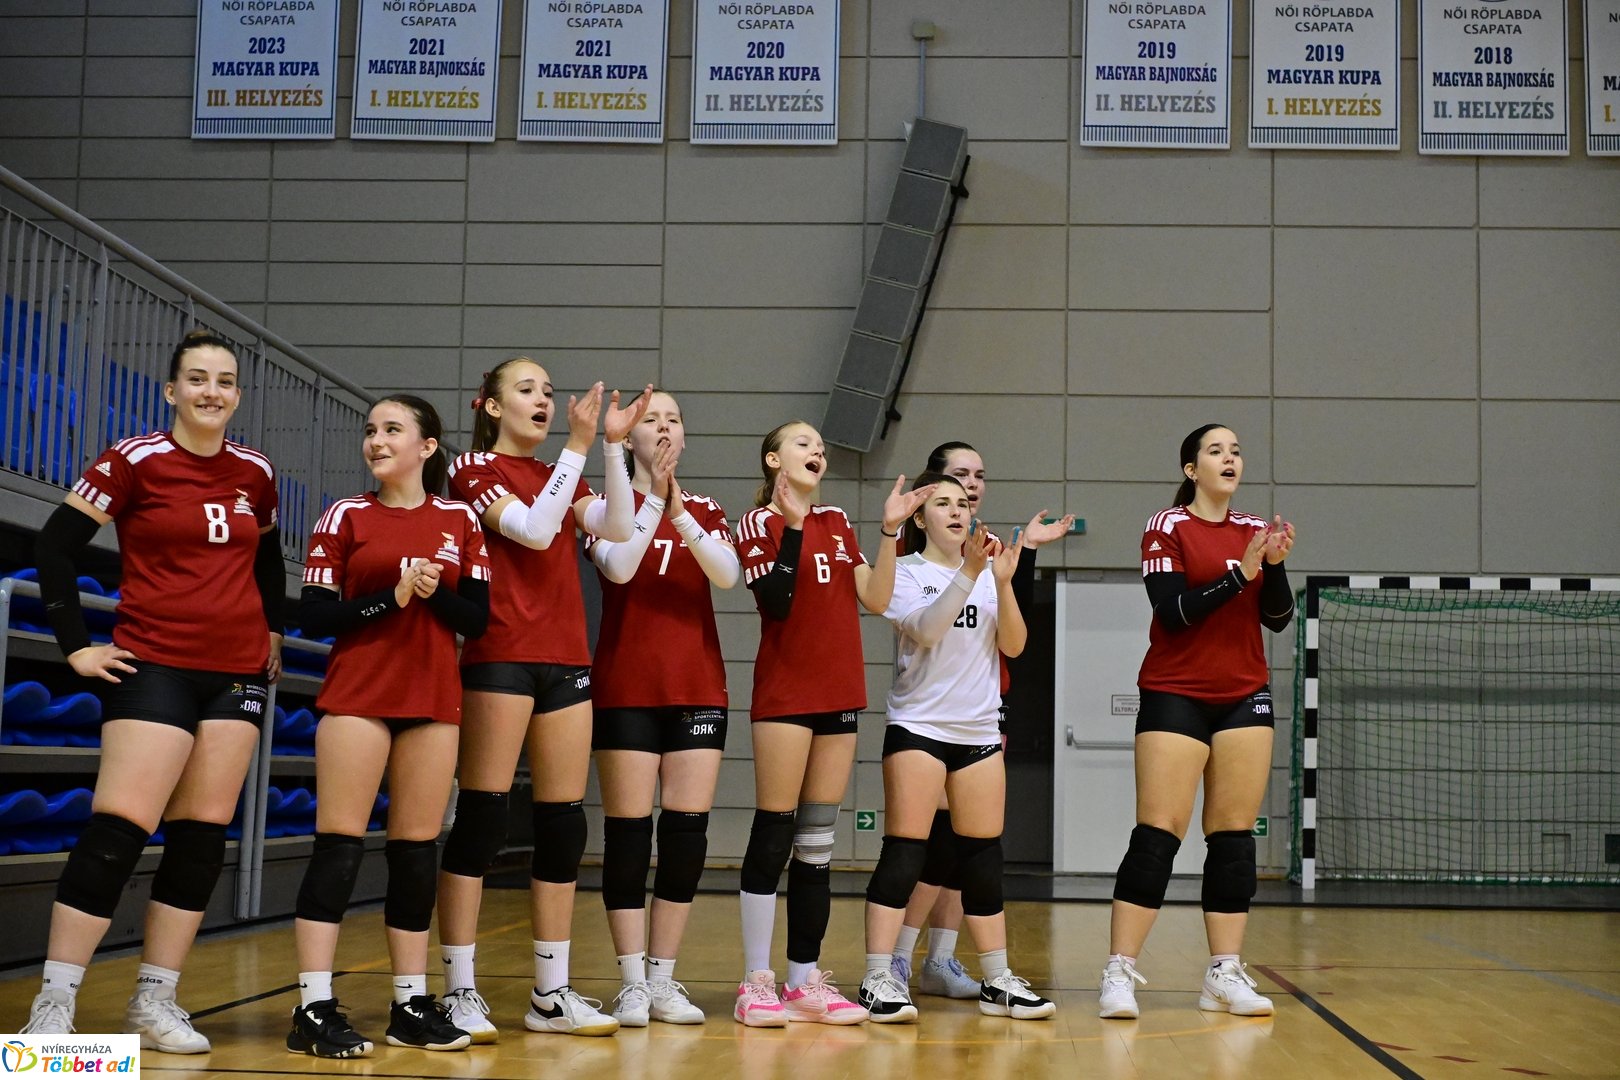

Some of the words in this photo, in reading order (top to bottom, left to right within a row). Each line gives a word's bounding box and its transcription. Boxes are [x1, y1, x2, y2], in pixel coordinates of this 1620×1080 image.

[548, 1, 571, 13] NŐI
[575, 2, 643, 14] RÖPLABDA
[719, 2, 742, 15] NŐI
[745, 2, 814, 15] RÖPLABDA
[1108, 2, 1133, 15] NŐI
[1135, 2, 1206, 16] RÖPLABDA
[1275, 4, 1300, 18] NŐI
[1302, 5, 1374, 18] RÖPLABDA
[1443, 8, 1467, 20] NŐI
[1471, 9, 1542, 20] RÖPLABDA
[240, 15, 295, 25] CSAPATA
[401, 16, 456, 27] CSAPATA
[567, 18, 623, 28] CSAPATA
[737, 19, 794, 30] CSAPATA
[1128, 19, 1186, 30] CSAPATA
[1295, 22, 1354, 33] CSAPATA
[1463, 24, 1522, 35] CSAPATA
[248, 37, 285, 54] 2023
[409, 38, 445, 56] 2021
[575, 40, 611, 57] 2021
[747, 41, 785, 59] 2020
[1137, 41, 1176, 59] 2019
[1305, 44, 1344, 62] 2019
[1474, 47, 1513, 64] 2018
[212, 62, 276, 76] MAGYAR
[279, 62, 320, 76] KUPA
[368, 59, 416, 75] MAGYAR
[419, 57, 485, 78] BAJNOKSÁG
[538, 63, 602, 80] MAGYAR
[606, 65, 648, 80] KUPA
[709, 66, 774, 81] MAGYAR
[778, 67, 821, 82] KUPA
[1095, 65, 1146, 81] MAGYAR
[1149, 63, 1217, 84] BAJNOKSÁG
[1267, 69, 1334, 85] MAGYAR
[1338, 70, 1382, 86] KUPA
[1432, 72, 1483, 87] MAGYAR
[1486, 68, 1555, 90] BAJNOKSÁG
[206, 89, 230, 107] III.
[235, 84, 323, 107] HELYEZÉS
[370, 90, 381, 107] I.
[386, 86, 480, 109] HELYEZÉS
[536, 91, 548, 109] I.
[552, 87, 647, 111] HELYEZÉS
[705, 94, 724, 112] II.
[729, 89, 824, 112] HELYEZÉS
[1095, 94, 1114, 112] II.
[1120, 90, 1216, 114] HELYEZÉS
[1266, 98, 1278, 116] I.
[1284, 93, 1382, 117] HELYEZÉS
[1433, 101, 1452, 118] II.
[1458, 96, 1555, 120] HELYEZÉS
[549, 473, 567, 496] KIPSTA
[203, 504, 229, 543] 8
[654, 539, 673, 575] 7
[400, 556, 422, 577] 1
[814, 553, 831, 584] 6
[953, 604, 978, 628] 28
